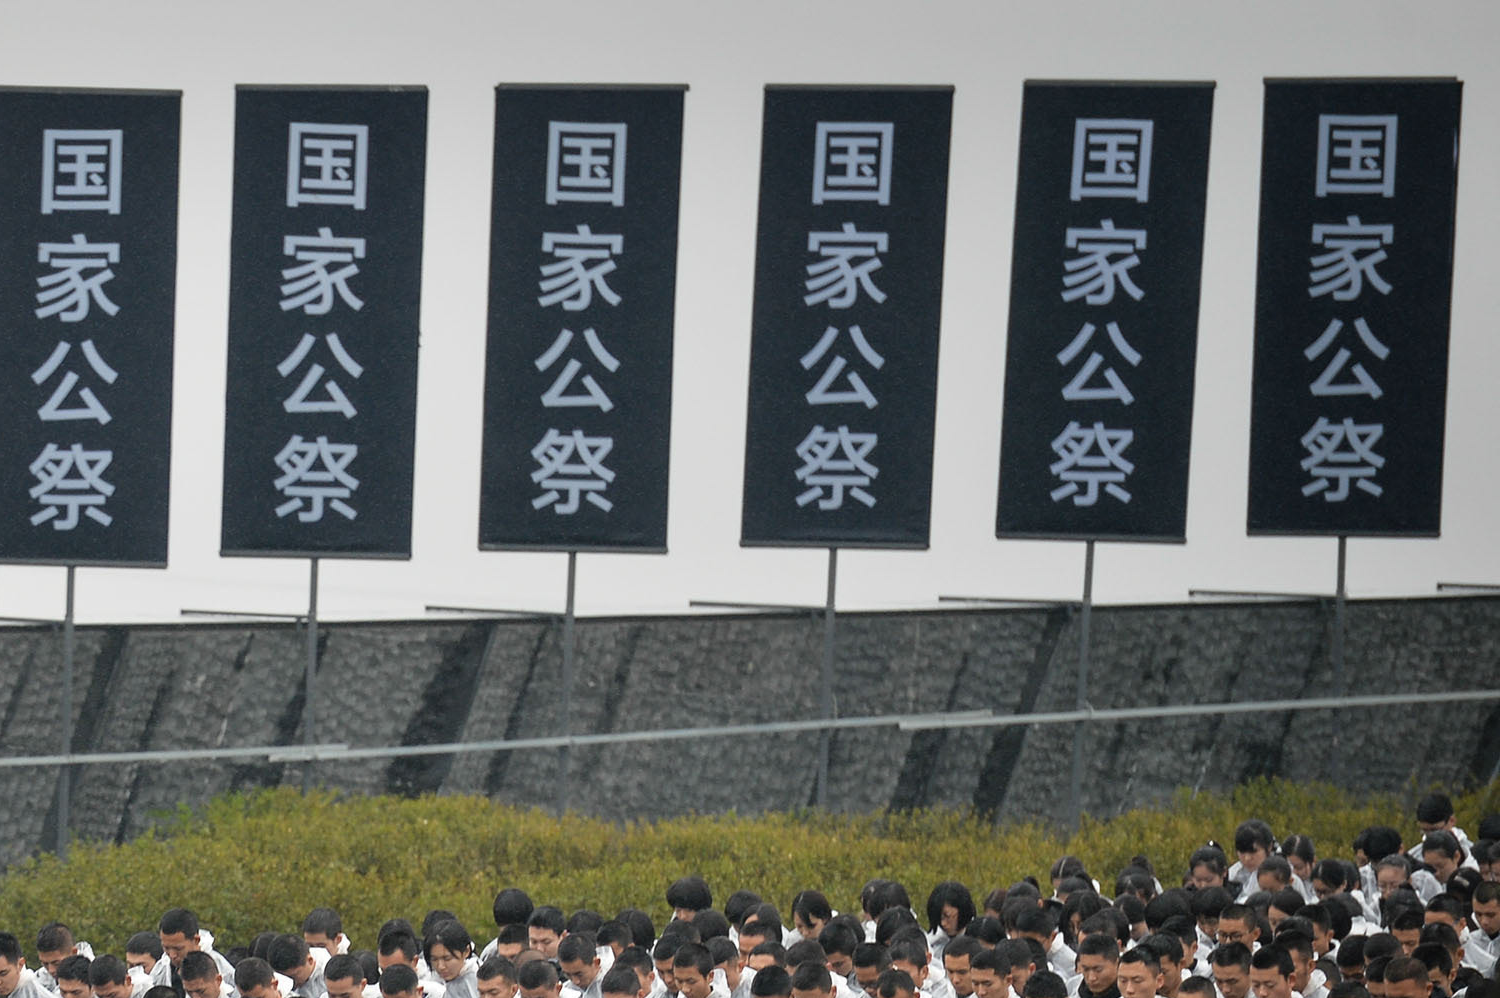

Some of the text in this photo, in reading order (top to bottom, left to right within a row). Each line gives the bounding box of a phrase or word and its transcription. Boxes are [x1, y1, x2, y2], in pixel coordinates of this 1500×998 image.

[29, 128, 123, 530] 国家公祭
[274, 121, 369, 522] 国家公祭
[531, 120, 627, 515] 国家公祭
[795, 121, 894, 510] 国家公祭
[1050, 118, 1153, 505] 国家公祭
[1300, 114, 1397, 501] 国家公祭
